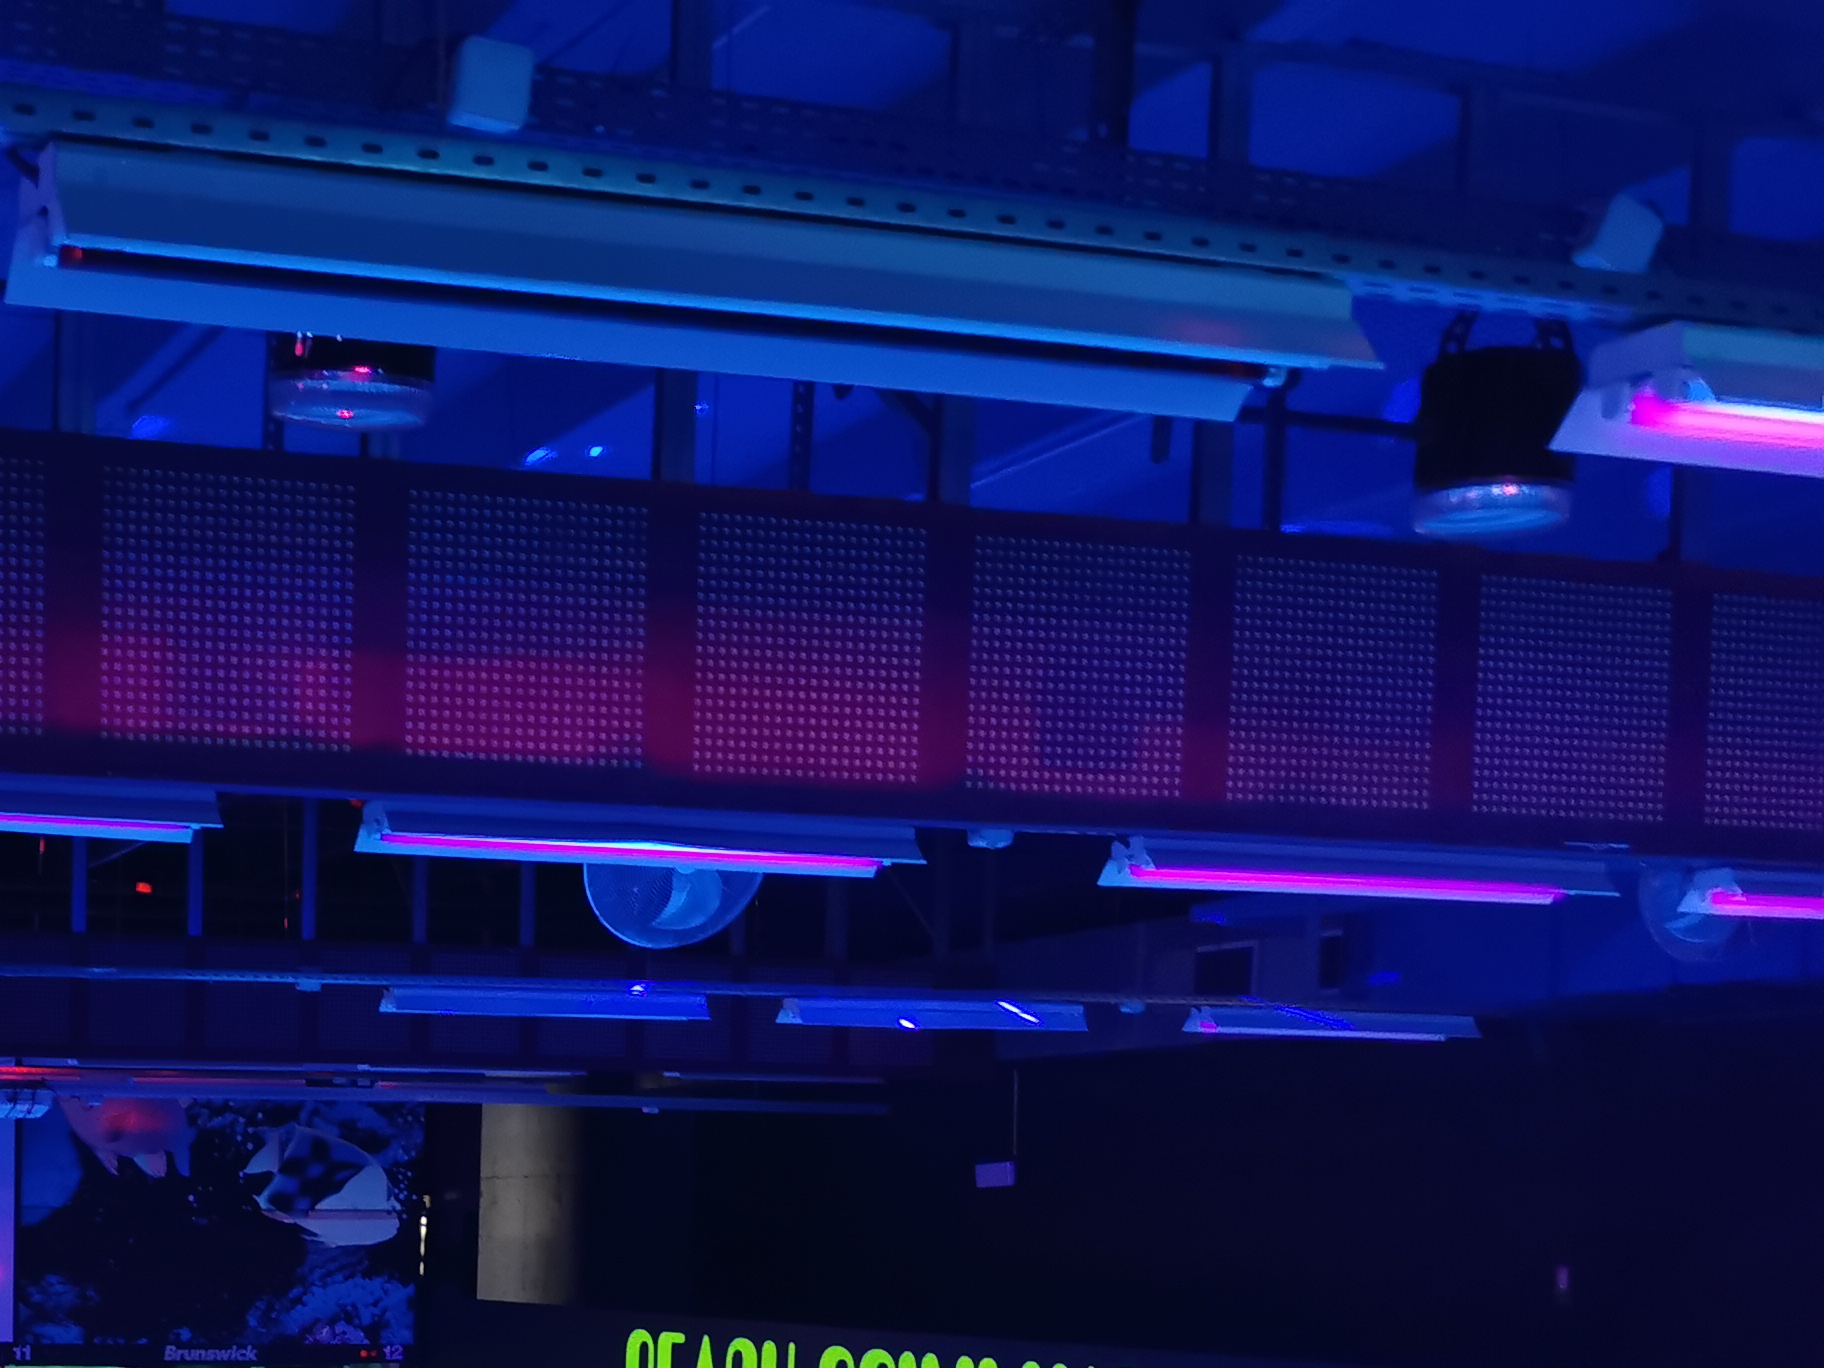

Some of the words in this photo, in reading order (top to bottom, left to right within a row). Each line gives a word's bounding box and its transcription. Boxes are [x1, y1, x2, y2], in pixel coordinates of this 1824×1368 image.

[12, 1345, 32, 1361] 11
[163, 1345, 259, 1362] Brunswick
[382, 1345, 405, 1361] 12
